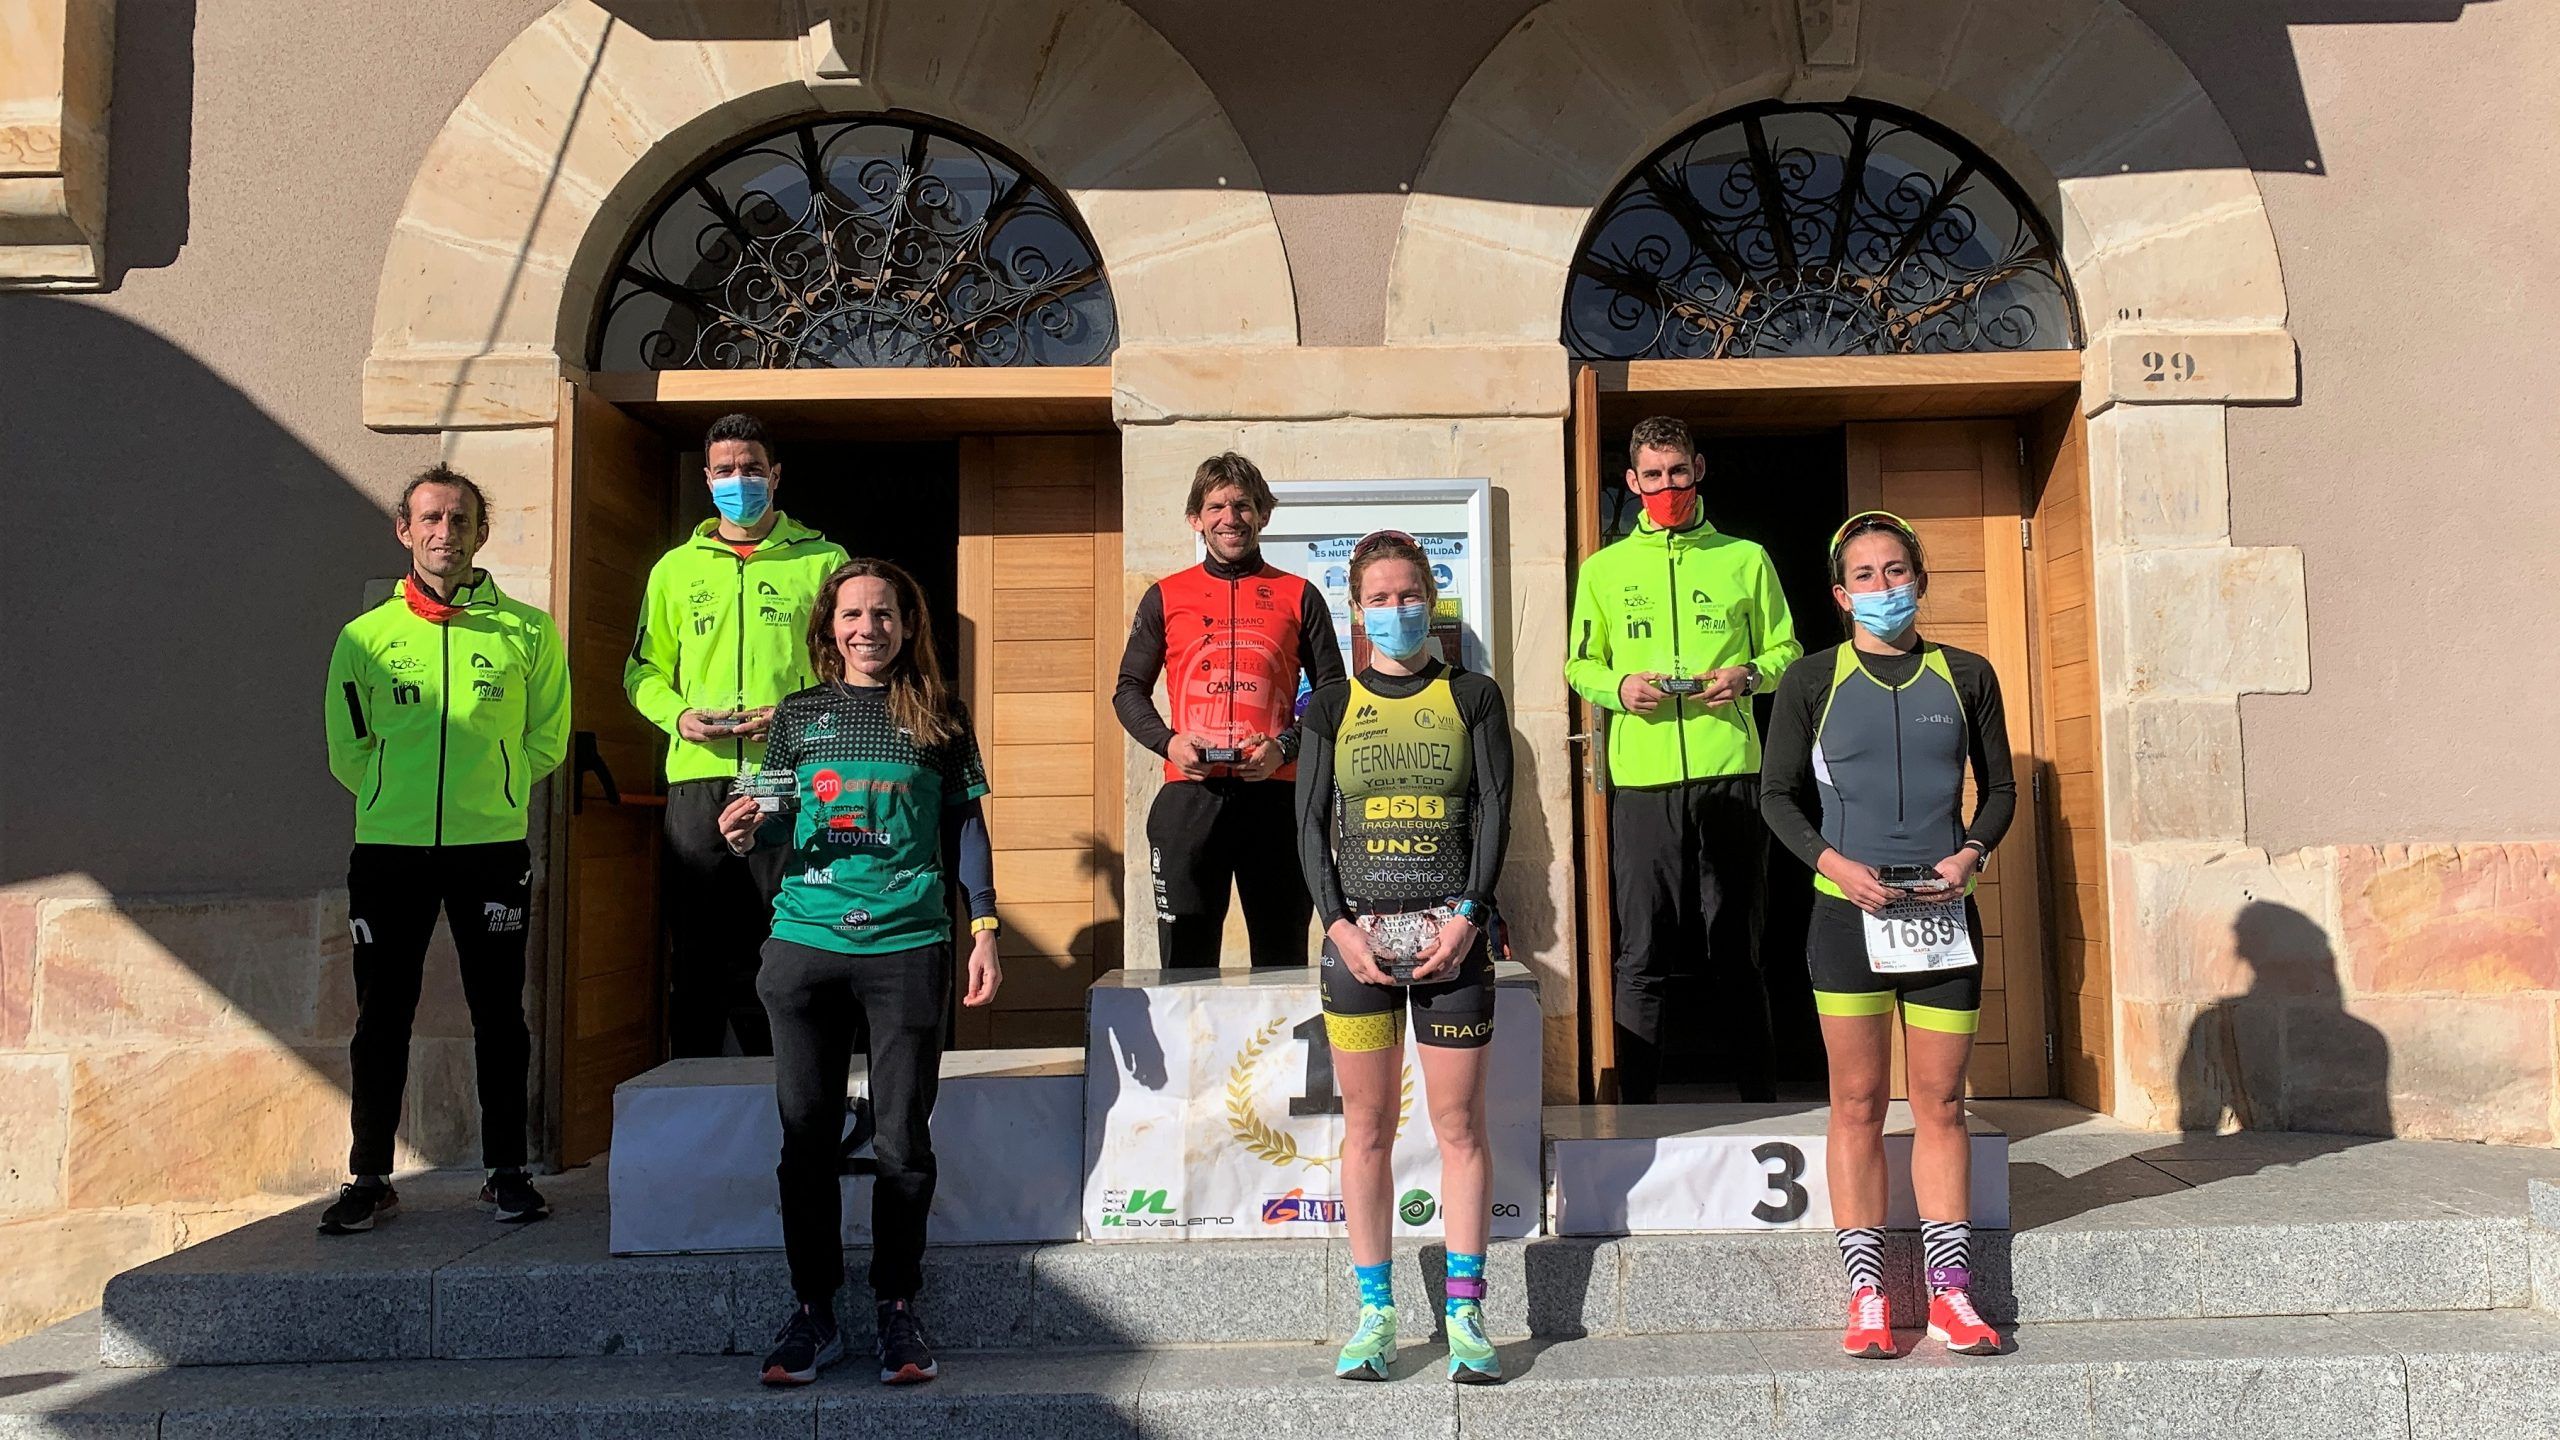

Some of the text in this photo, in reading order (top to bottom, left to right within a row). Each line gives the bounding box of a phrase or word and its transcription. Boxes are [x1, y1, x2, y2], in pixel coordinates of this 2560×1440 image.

[2142, 352, 2195, 382] 29
[1333, 539, 1344, 547] LA
[1436, 600, 1457, 611] EATRO
[1930, 714, 1953, 724] dhb
[1352, 742, 1453, 777] FERNANDEZ
[1361, 820, 1450, 831] TRAGALEGUAS
[827, 828, 891, 846] trayma
[1886, 906, 1930, 915] CASTILLA
[1881, 916, 1955, 949] 1689
[1289, 1013, 1344, 1117] 1
[1751, 1142, 1811, 1223] 3
